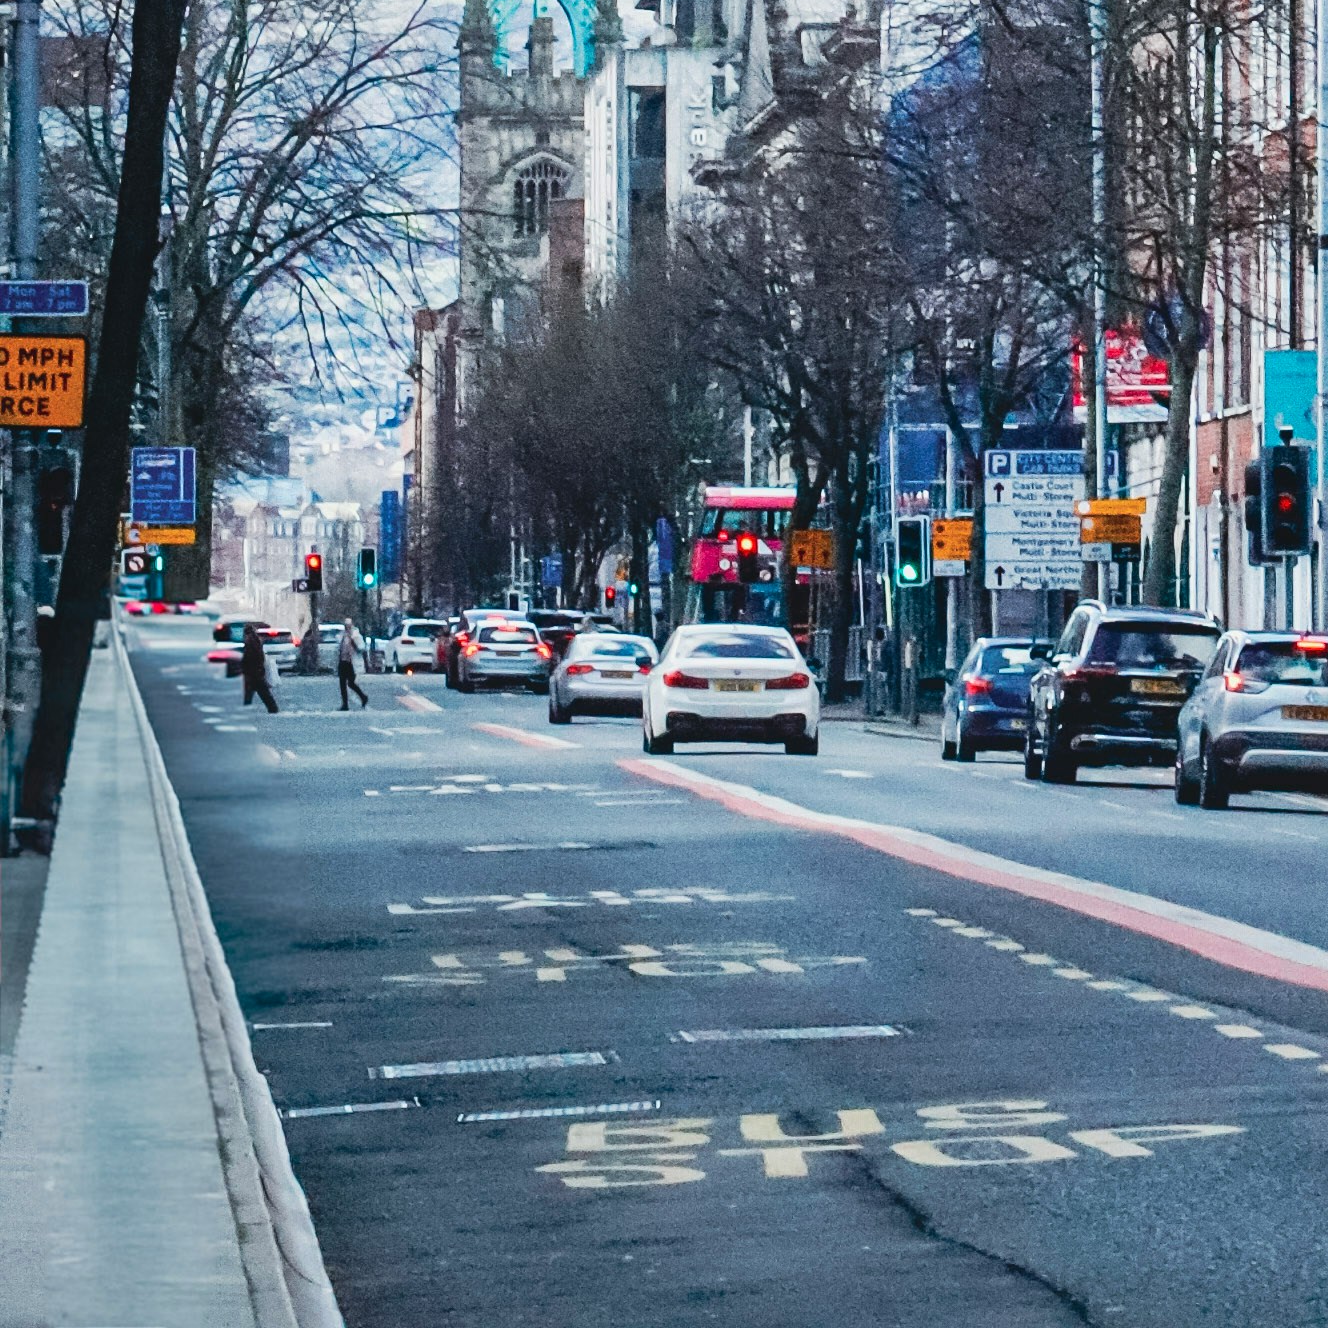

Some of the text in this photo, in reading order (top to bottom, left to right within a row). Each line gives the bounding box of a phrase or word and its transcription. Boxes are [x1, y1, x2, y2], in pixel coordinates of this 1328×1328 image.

[18, 347, 75, 367] MPH
[4, 372, 72, 392] LIMIT
[0, 396, 51, 417] RCE
[991, 454, 1008, 474] P
[1012, 481, 1074, 490] Castle Court
[1013, 509, 1052, 518] Victoria
[1012, 538, 1074, 547] Montgomery
[1046, 565, 1080, 574] Northe
[563, 1099, 1068, 1152] BUS
[533, 1123, 1247, 1188] STOP
